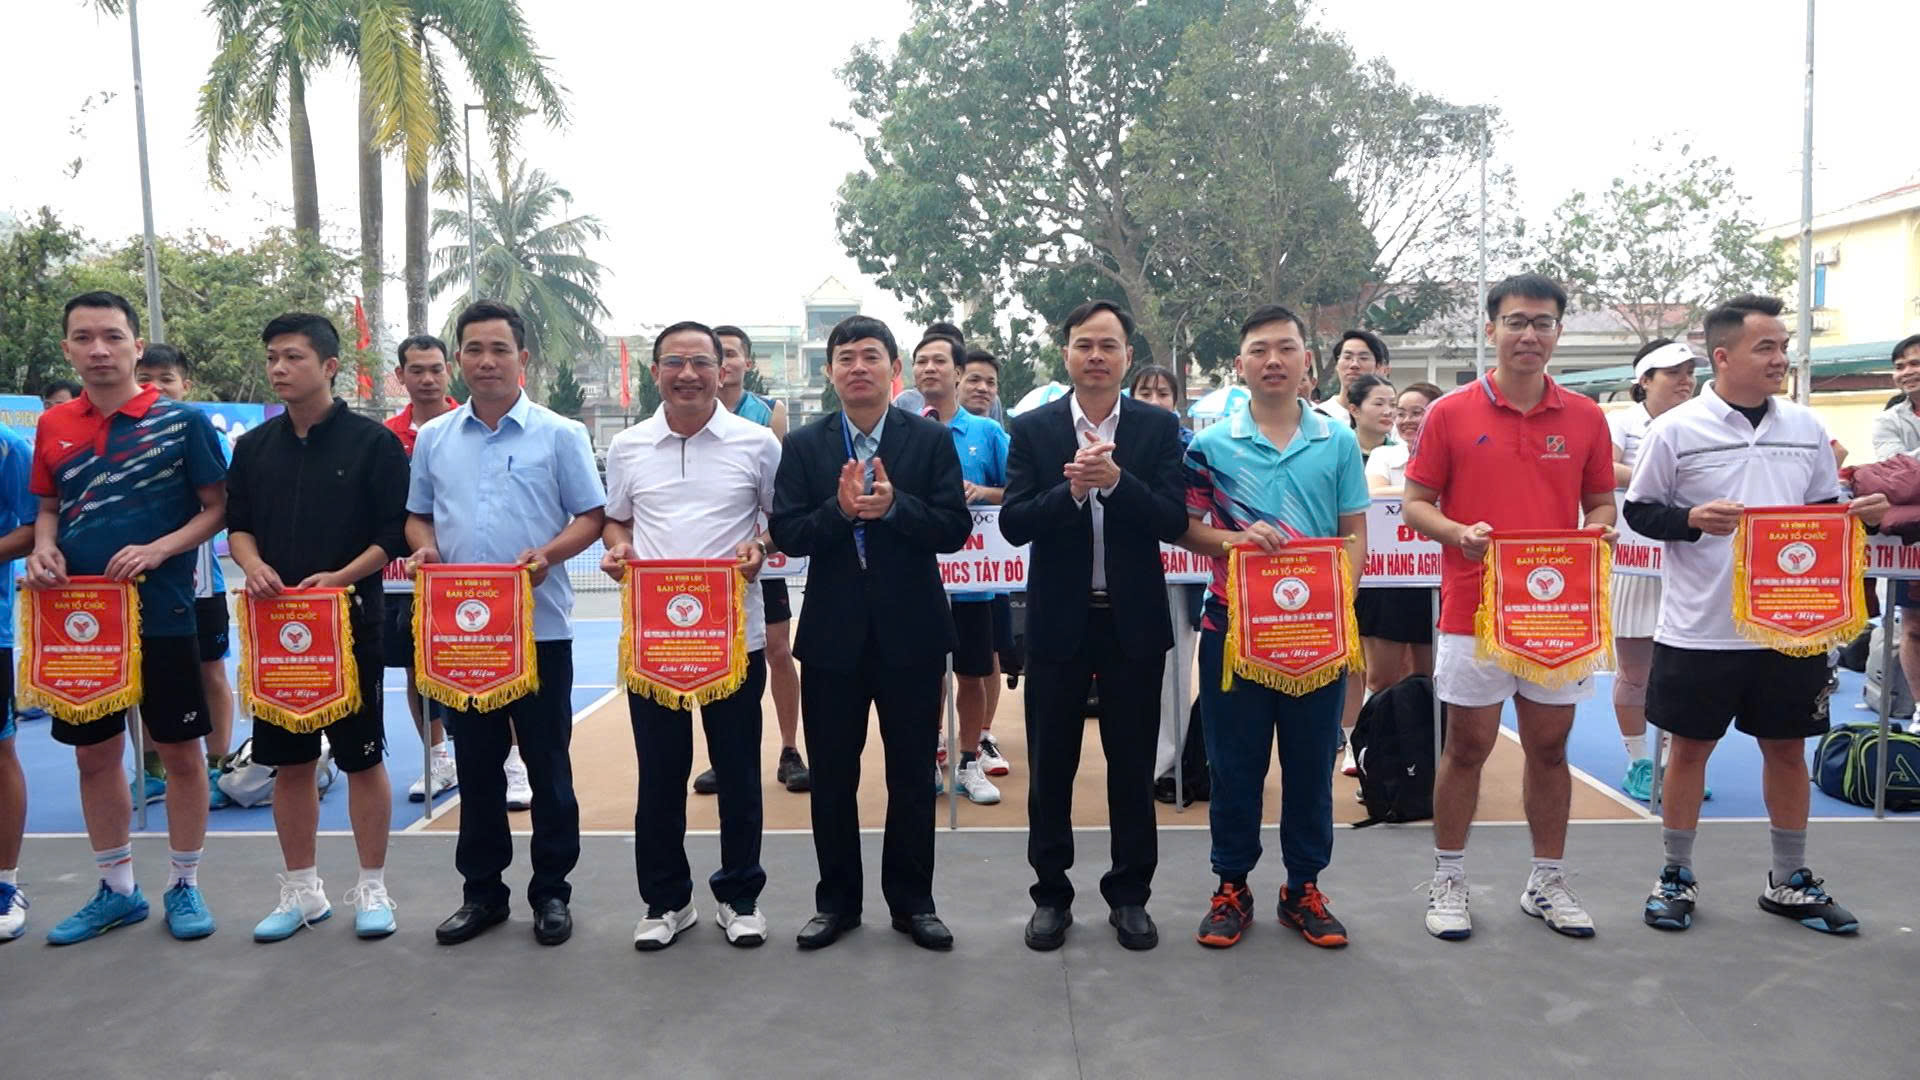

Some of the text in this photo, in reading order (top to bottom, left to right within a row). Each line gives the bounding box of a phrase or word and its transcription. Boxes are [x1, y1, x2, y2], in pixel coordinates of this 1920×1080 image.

[1387, 547, 1415, 576] HÀNG
[1615, 539, 1650, 568] NHÁNH
[1876, 544, 1894, 568] TH
[974, 555, 1000, 582] TÂY
[1004, 554, 1024, 582] ĐÔ
[1261, 569, 1279, 577] BAN
